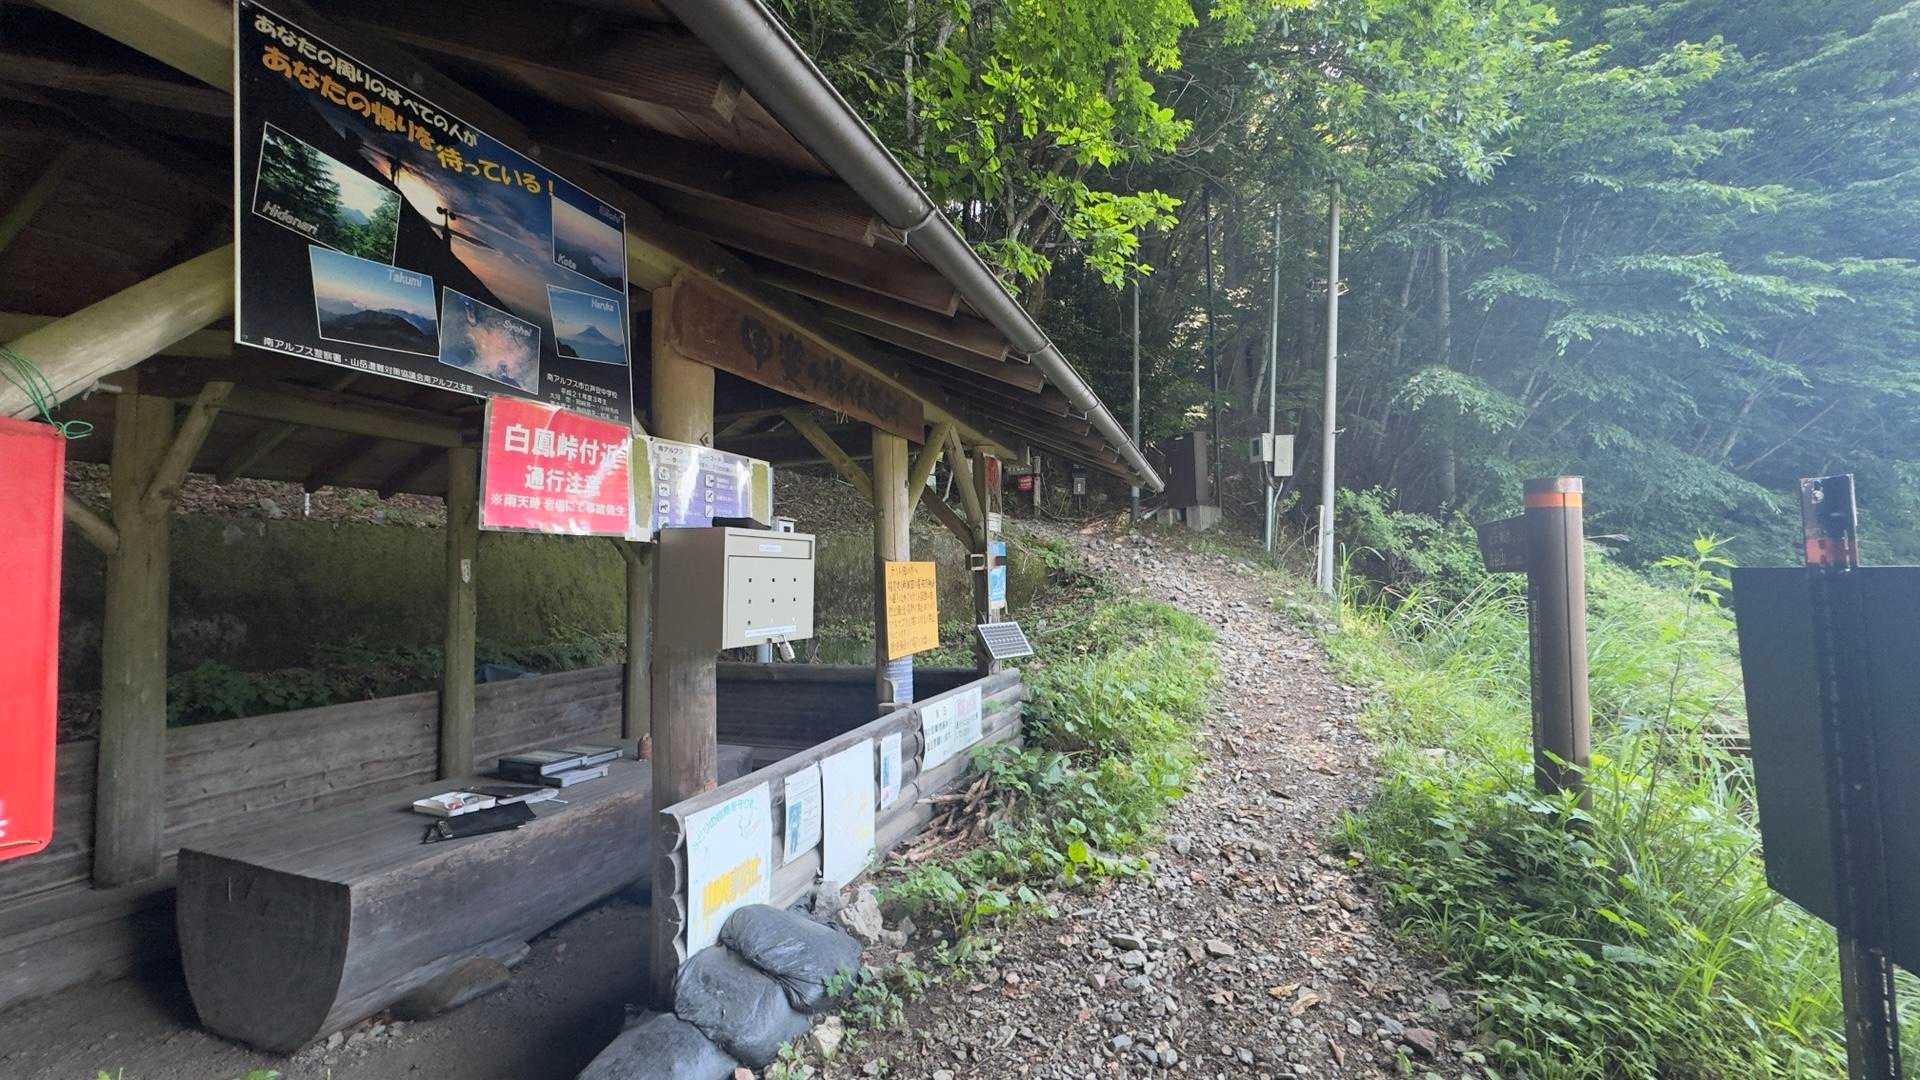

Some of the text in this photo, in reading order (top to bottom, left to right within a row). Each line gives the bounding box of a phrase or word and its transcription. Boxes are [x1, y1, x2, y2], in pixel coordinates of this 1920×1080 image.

[388, 269, 422, 288] Takumi
[524, 464, 602, 499] 通行注意
